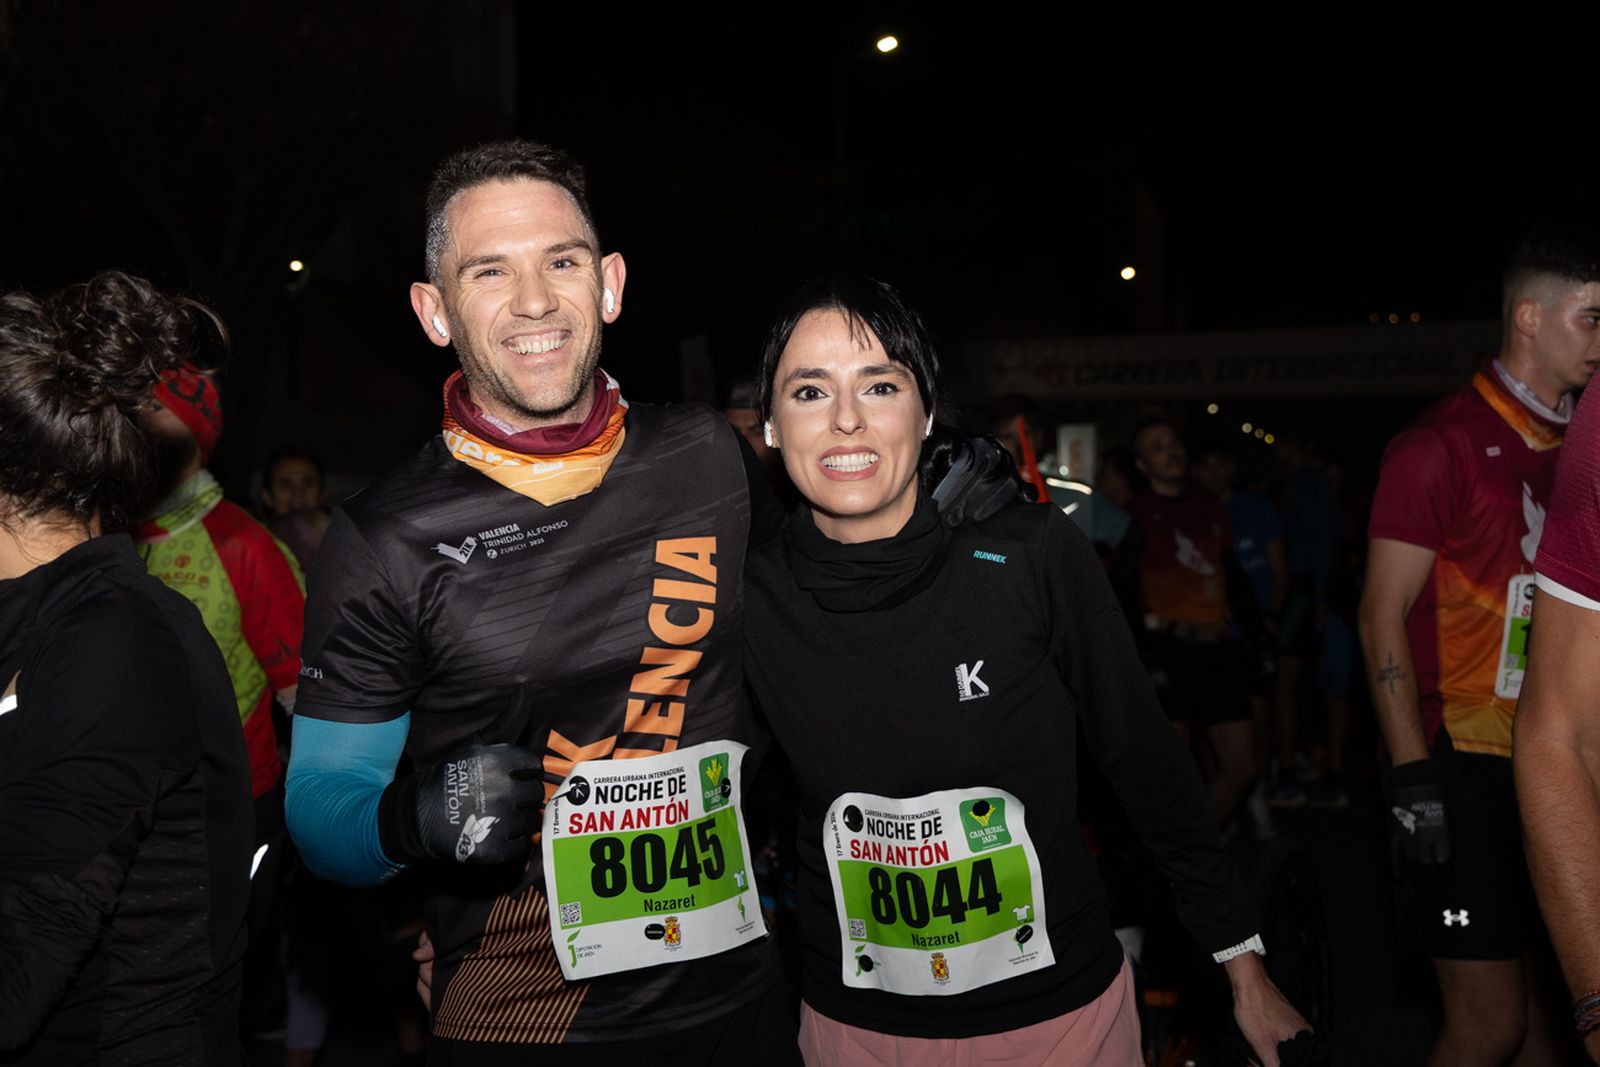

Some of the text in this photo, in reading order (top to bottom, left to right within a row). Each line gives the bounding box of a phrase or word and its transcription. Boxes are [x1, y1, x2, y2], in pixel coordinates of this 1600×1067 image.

[1074, 360, 1200, 387] CARRERA
[1215, 353, 1460, 383] INTERNACIONAL
[478, 523, 520, 540] VALENCIA
[482, 520, 569, 549] TRINIDAD ALFONSO
[500, 543, 527, 555] ZURICH
[612, 536, 717, 760] LENCIA
[457, 760, 469, 797] SAN
[594, 766, 685, 784] CARRERA URBANA INTERNACIONAL
[595, 774, 687, 805] NOCHE DE
[568, 797, 689, 834] SAN ANTÓN
[867, 816, 943, 840] NOCHE DE
[900, 808, 940, 820] INTERNACIONAL
[589, 818, 726, 899] 8045
[850, 839, 949, 867] SAN ANTÓN
[644, 894, 696, 912] Nazaret
[868, 857, 1003, 929] 8044
[911, 930, 960, 947] Nazaret
